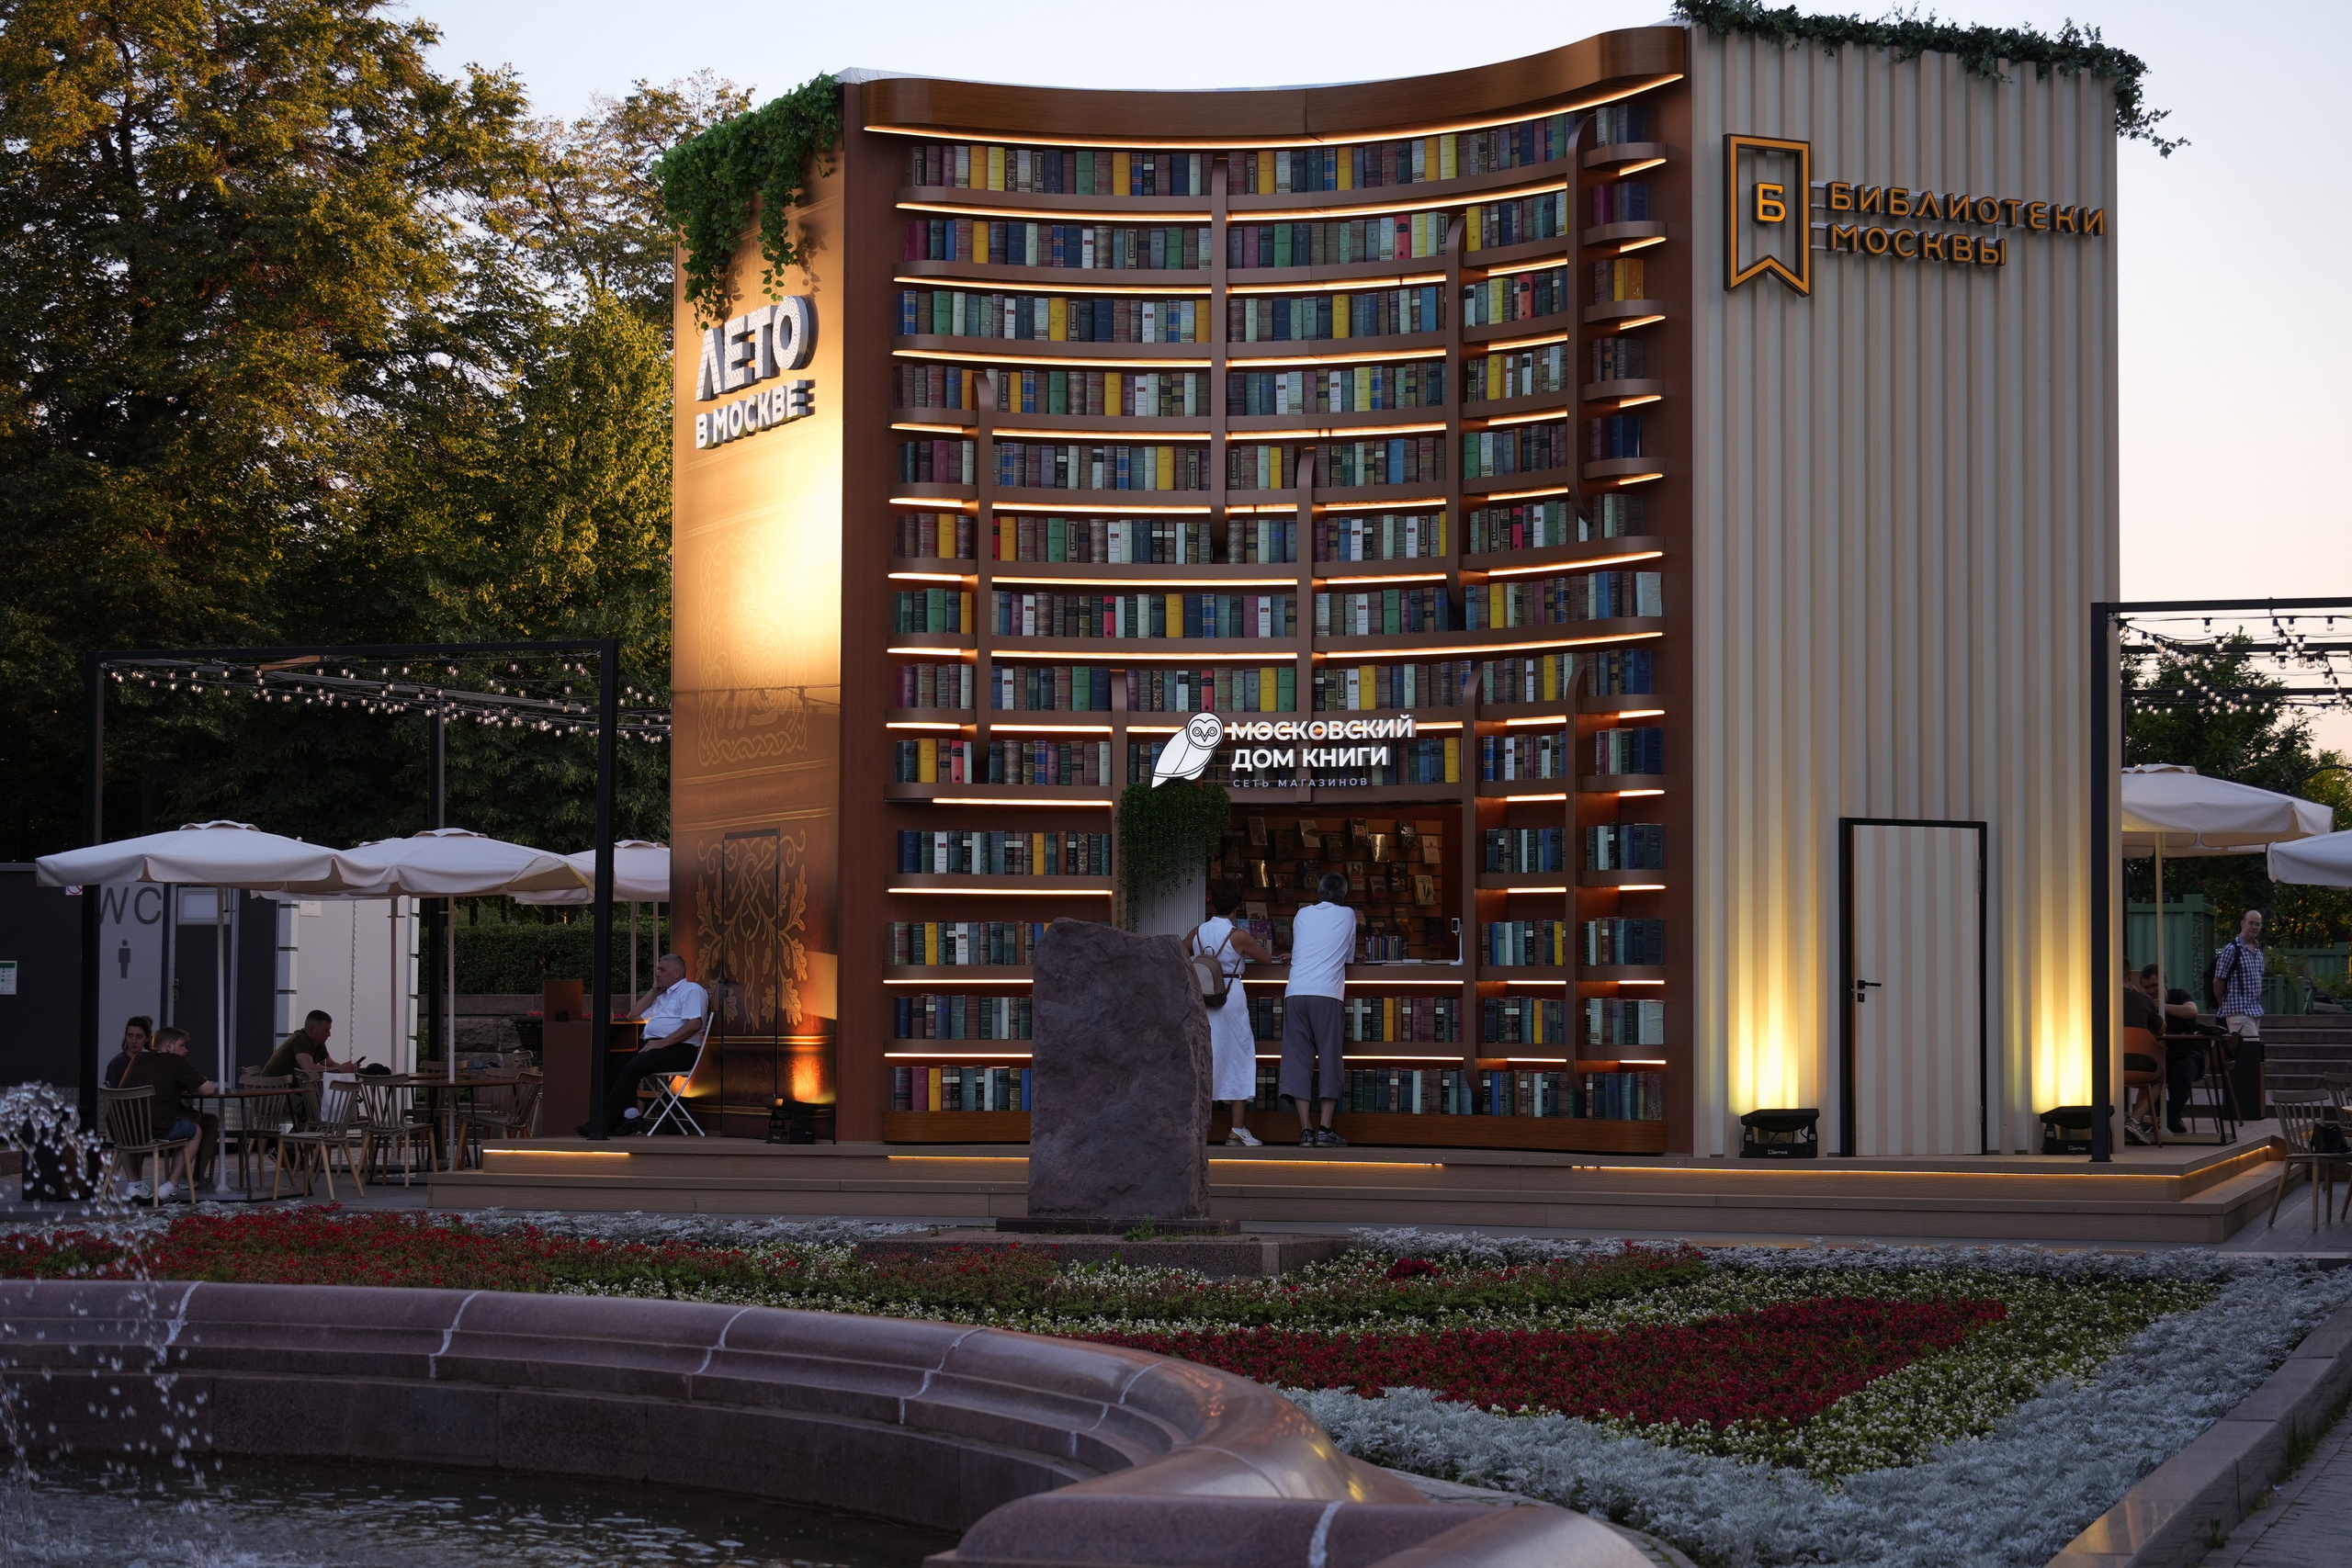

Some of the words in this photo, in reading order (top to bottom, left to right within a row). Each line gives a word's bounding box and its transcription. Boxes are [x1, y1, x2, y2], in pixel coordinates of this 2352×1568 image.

[1755, 182, 1787, 223] Б
[1826, 181, 2105, 236] БИБЛИОТЕКИ
[1826, 223, 2007, 266] МОСКВЫ
[695, 295, 809, 401] ЛЕТО
[695, 412, 714, 449] В
[713, 379, 807, 444] МОСКВЕ
[1231, 714, 1415, 740] МОСКОВСКИЙ
[1231, 749, 1295, 772] ДОМ
[1303, 746, 1389, 767] КНИГИ
[1232, 779, 1270, 788] СЕТЬ
[1278, 777, 1369, 787] МАГАЗИНОВ
[100, 886, 162, 925] WC
